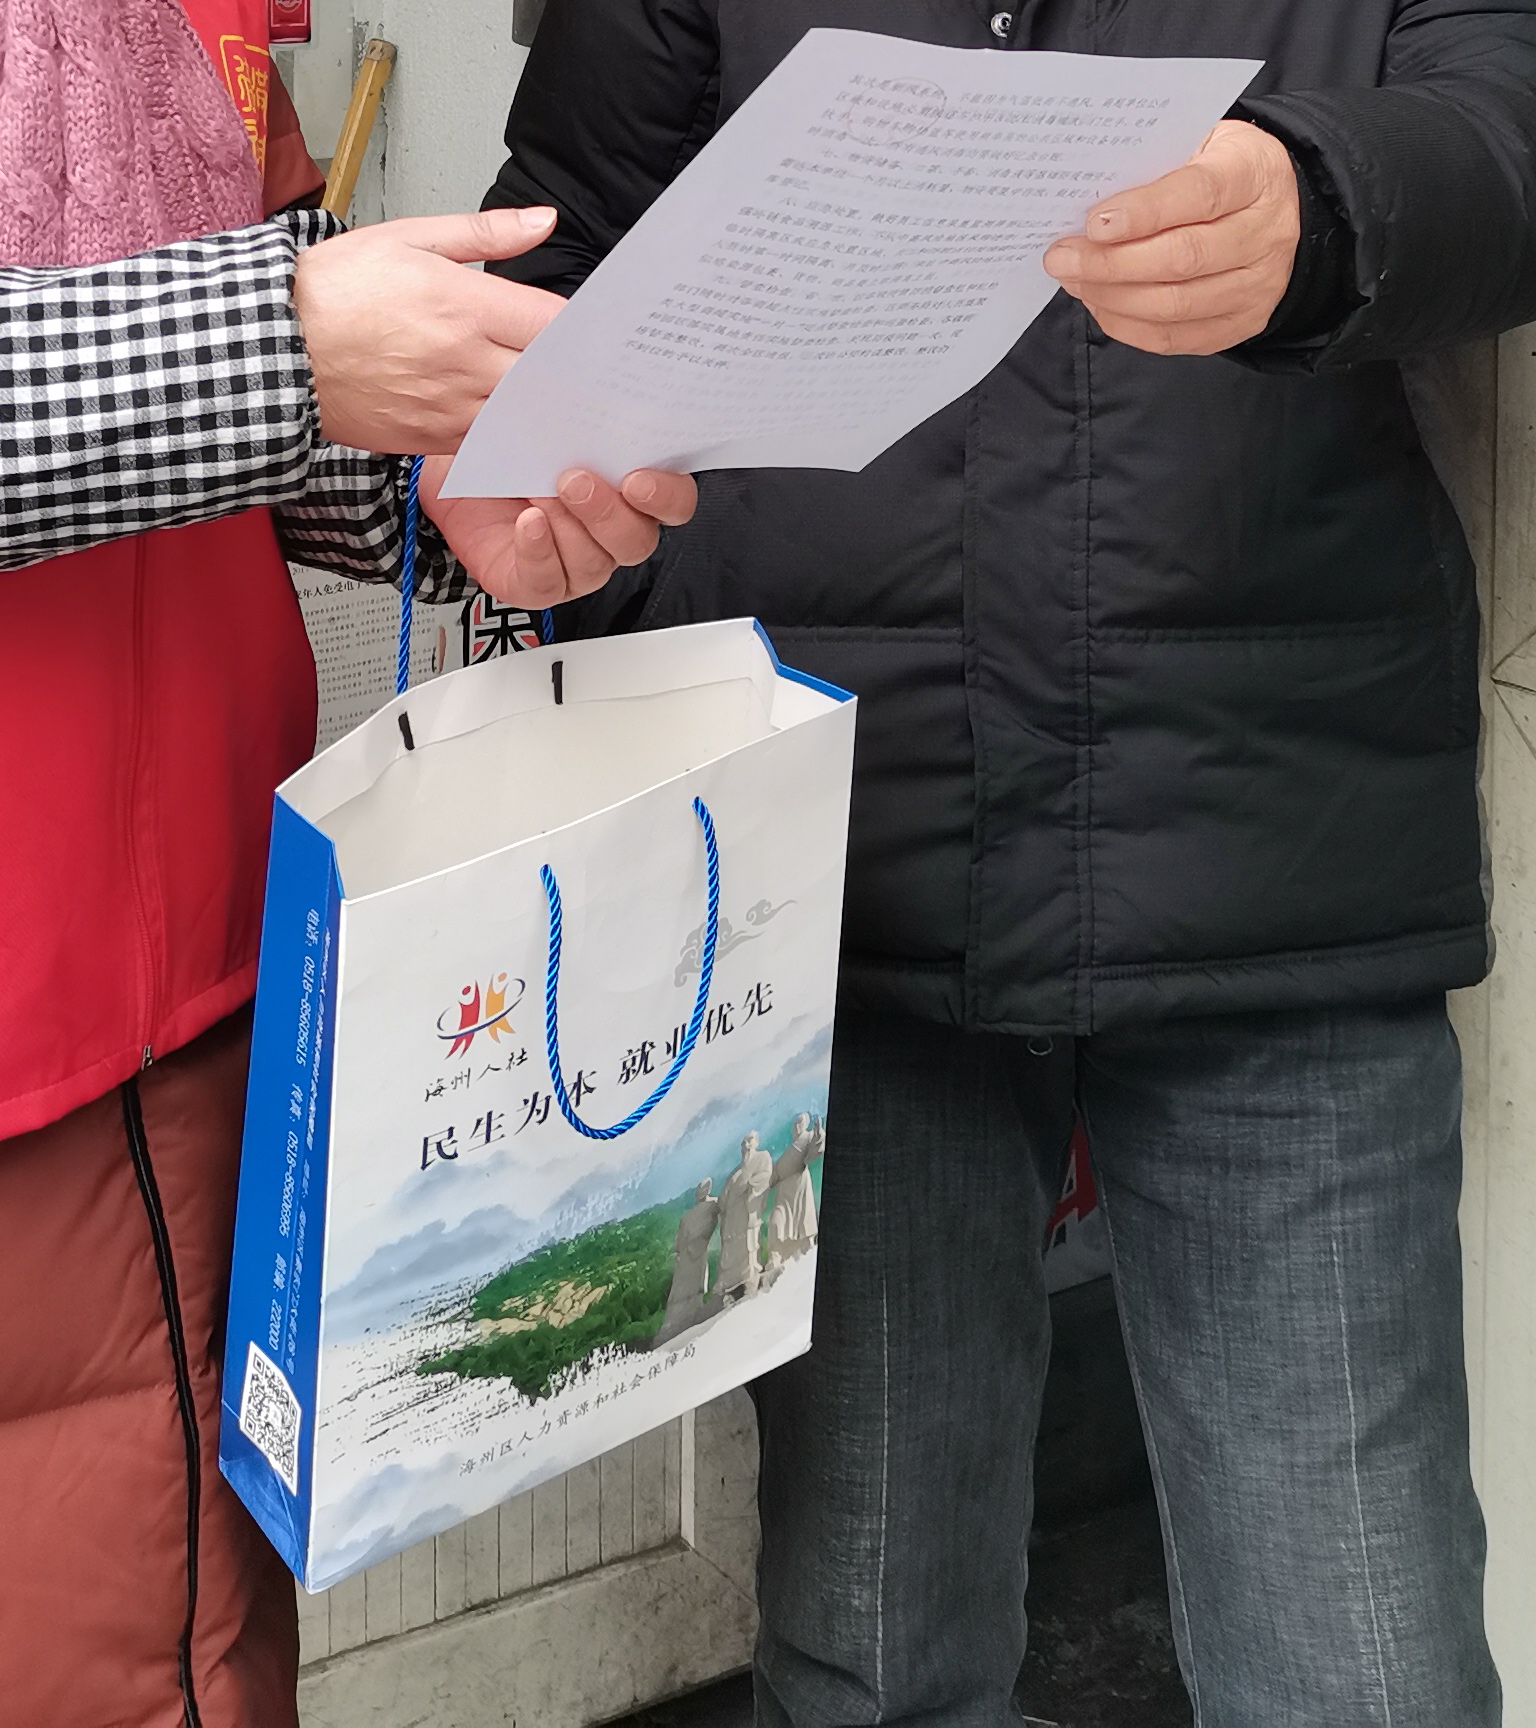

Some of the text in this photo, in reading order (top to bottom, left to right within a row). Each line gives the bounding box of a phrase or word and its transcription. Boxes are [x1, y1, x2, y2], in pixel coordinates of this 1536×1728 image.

[420, 981, 774, 1171] 民生为本 就业优先
[425, 1046, 529, 1102] 海州人社
[459, 1343, 697, 1477] 海州区人力资源和社会保障局
